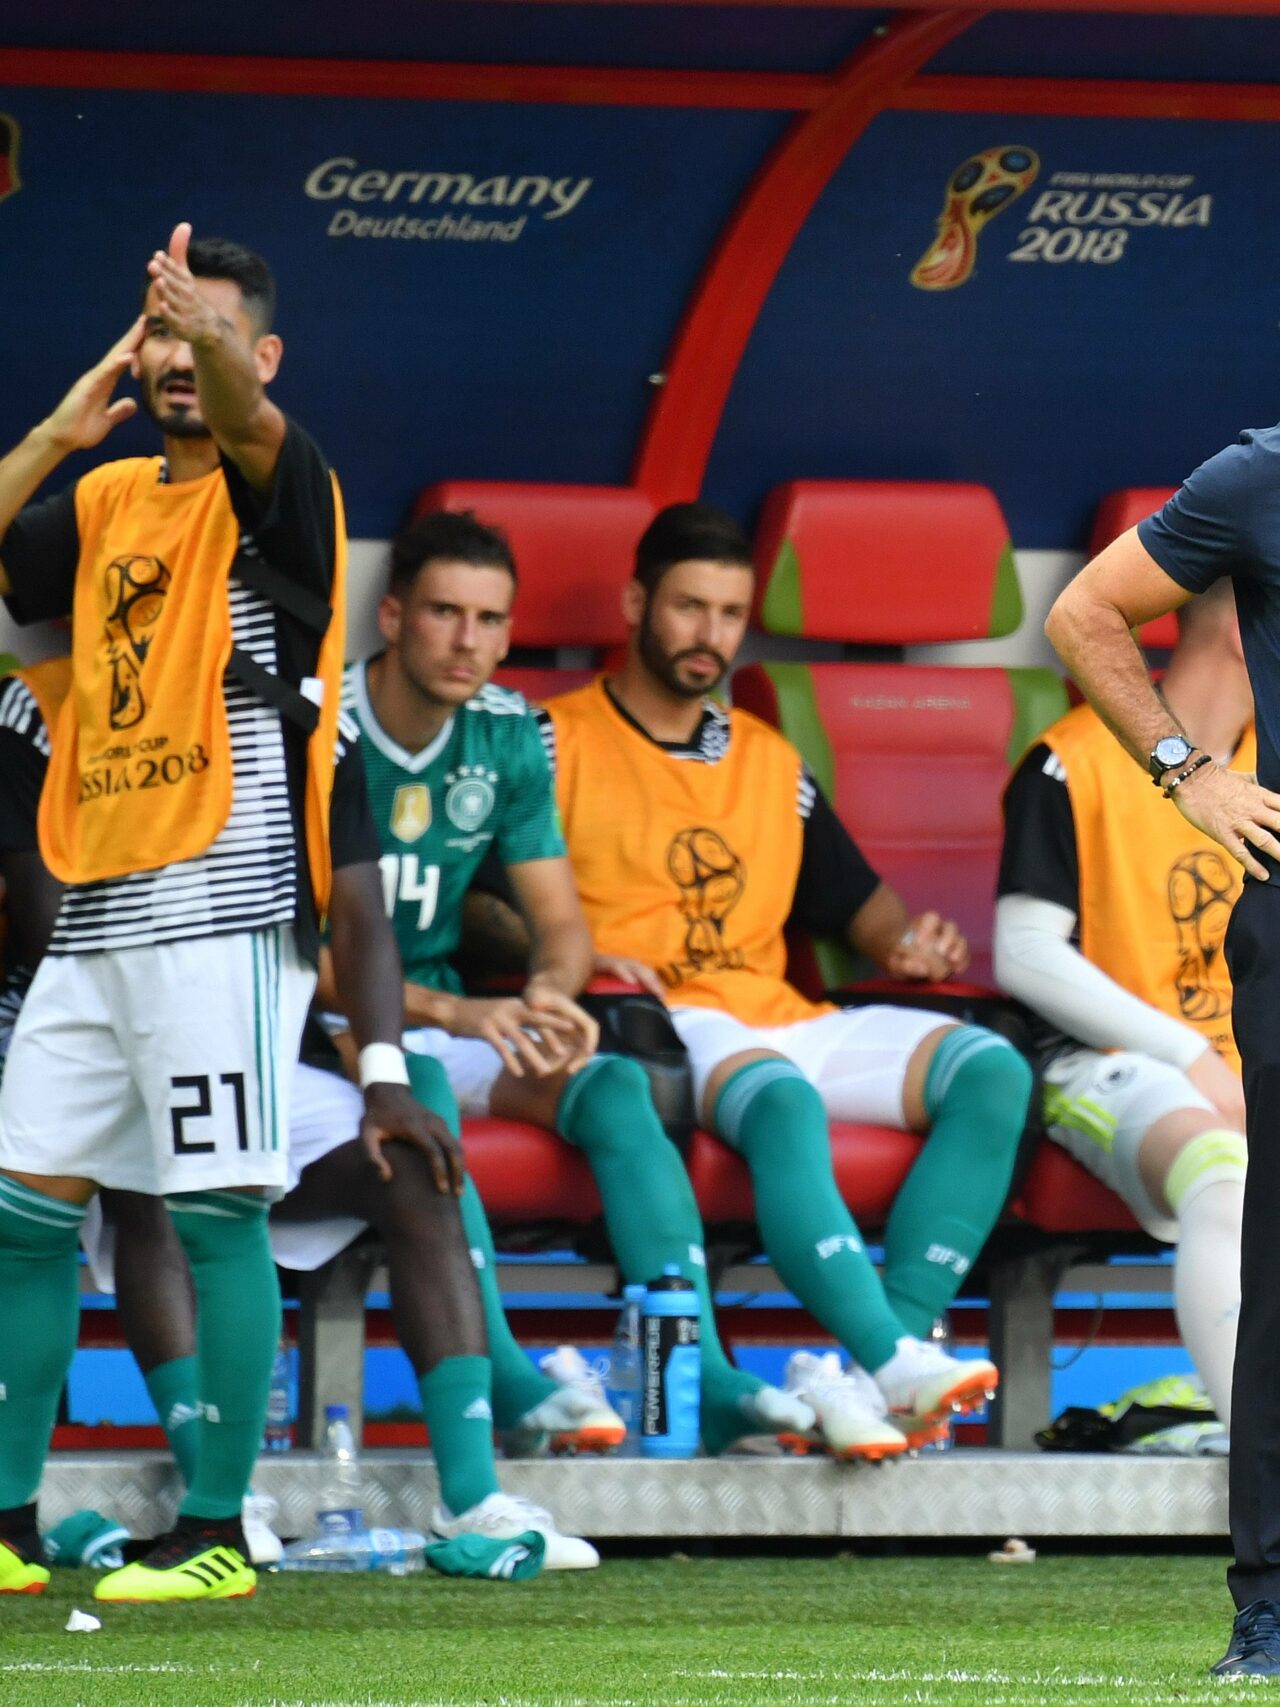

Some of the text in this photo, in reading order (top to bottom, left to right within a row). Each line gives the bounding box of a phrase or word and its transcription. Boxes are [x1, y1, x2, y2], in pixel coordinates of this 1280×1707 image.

[304, 157, 593, 220] Germany
[1027, 190, 1213, 227] RUSSIA
[326, 209, 528, 242] Deutschland
[1007, 226, 1129, 263] 2018
[378, 842, 441, 931] 14
[170, 1072, 249, 1155] 21
[644, 1316, 661, 1436] POWERADE
